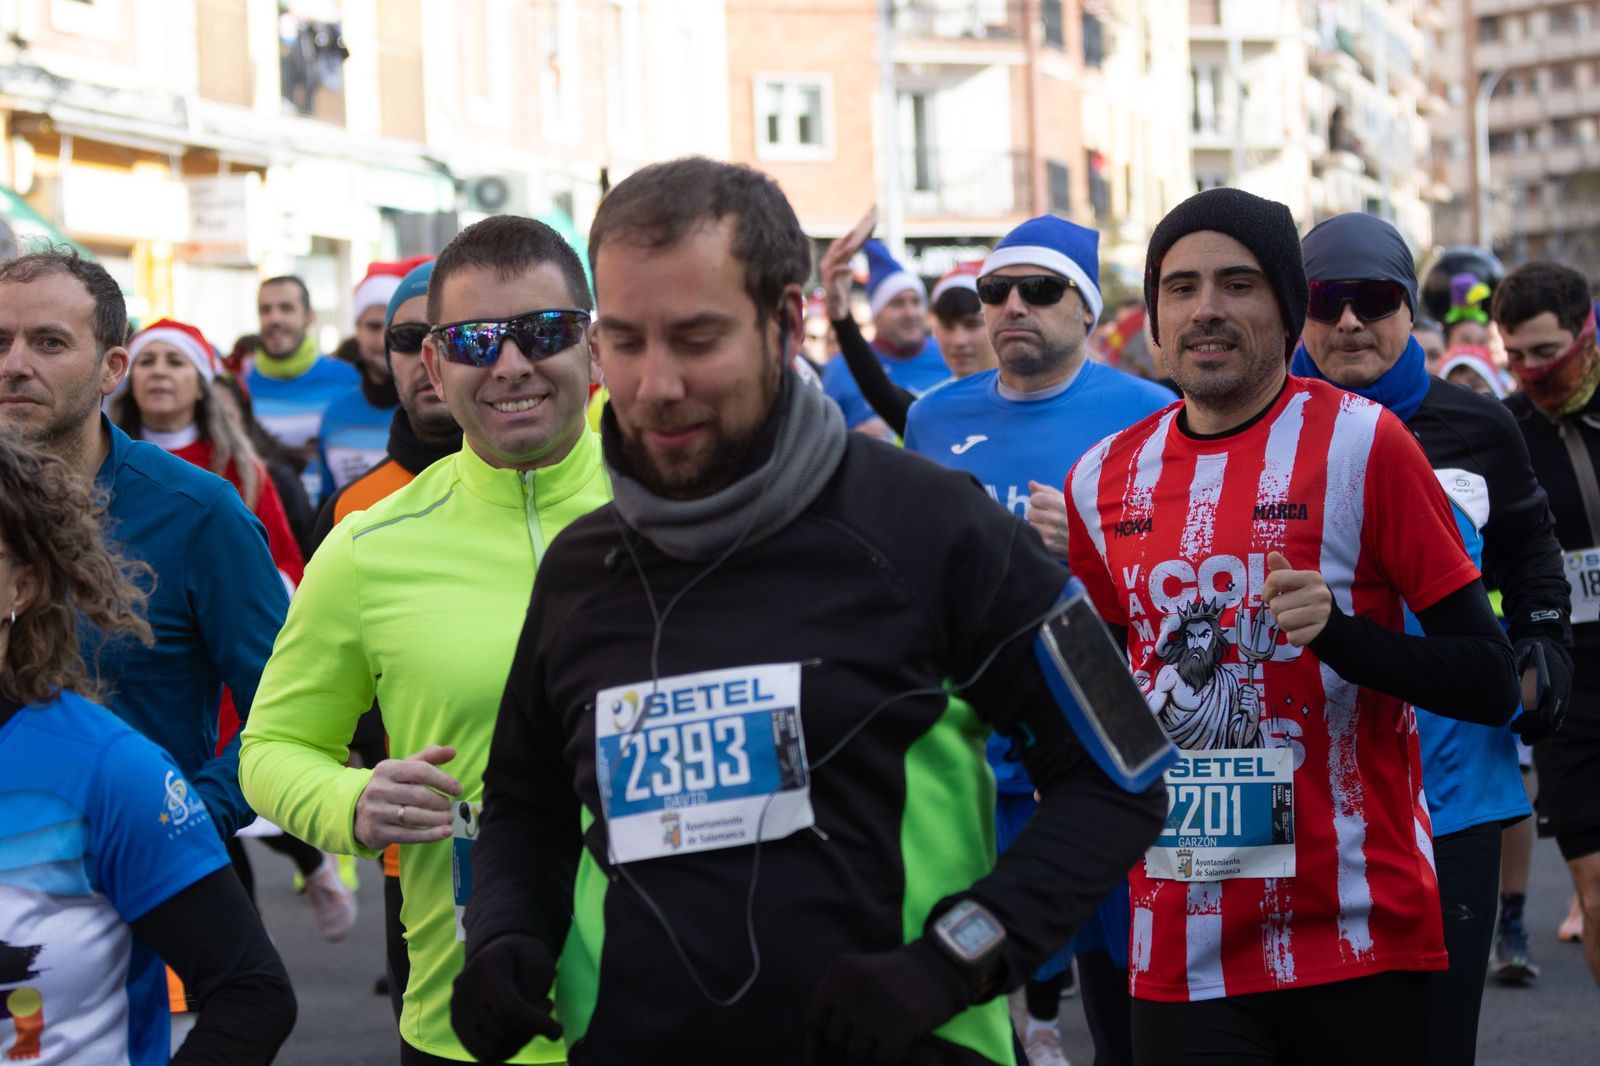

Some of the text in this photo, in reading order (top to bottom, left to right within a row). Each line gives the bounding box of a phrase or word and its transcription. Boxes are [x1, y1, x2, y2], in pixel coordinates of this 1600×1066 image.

[1252, 503, 1308, 521] MARCA
[1114, 518, 1153, 538] HOKA
[647, 679, 774, 717] SETEL
[620, 716, 750, 802] 2393
[1169, 757, 1275, 777] SETEL
[664, 791, 708, 810] DAVID
[686, 816, 744, 832] Ayuntamiento
[686, 829, 746, 846] de Salamanca
[1178, 834, 1217, 847] GARZÓN
[1195, 858, 1240, 868] Ayuntamiento
[1195, 867, 1241, 877] de Salamanca
